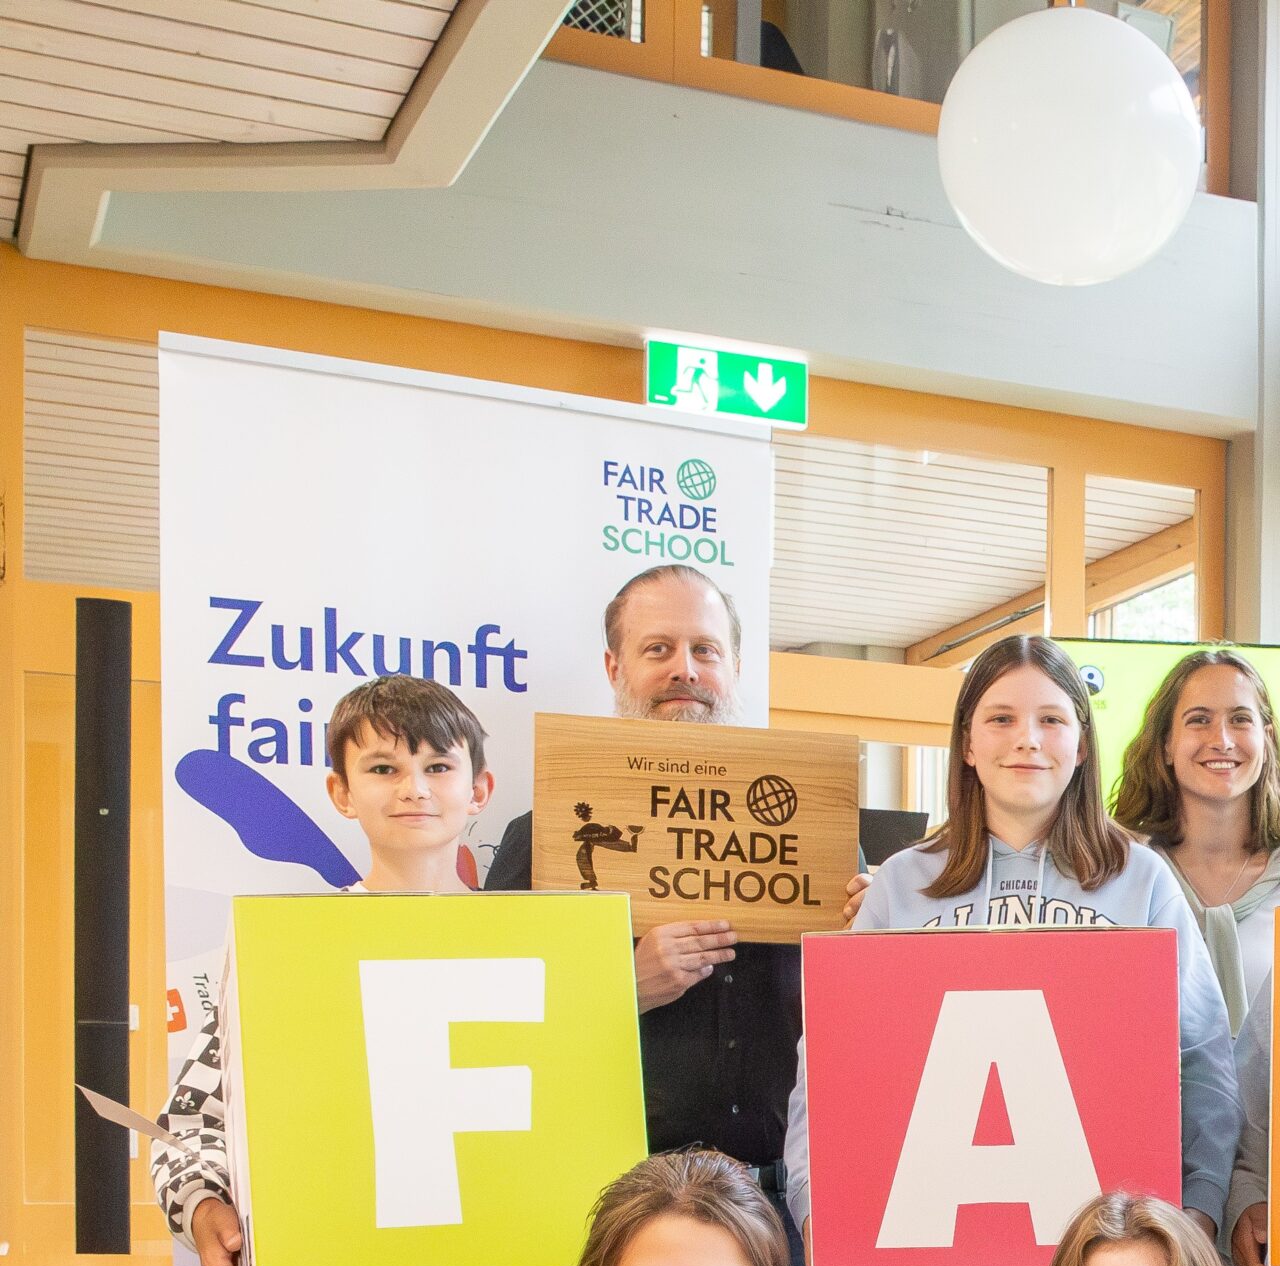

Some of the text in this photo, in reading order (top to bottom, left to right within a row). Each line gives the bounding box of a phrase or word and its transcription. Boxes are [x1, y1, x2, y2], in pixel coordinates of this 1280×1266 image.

[603, 460, 668, 495] FAIR
[616, 494, 717, 533] TRADE
[602, 525, 735, 566] SCHOOL
[207, 596, 528, 693] Zukunft
[627, 756, 728, 777] Wir sind eine
[650, 785, 735, 822] FAIR
[667, 827, 798, 866] TRADE
[648, 865, 821, 906] SCHOOL
